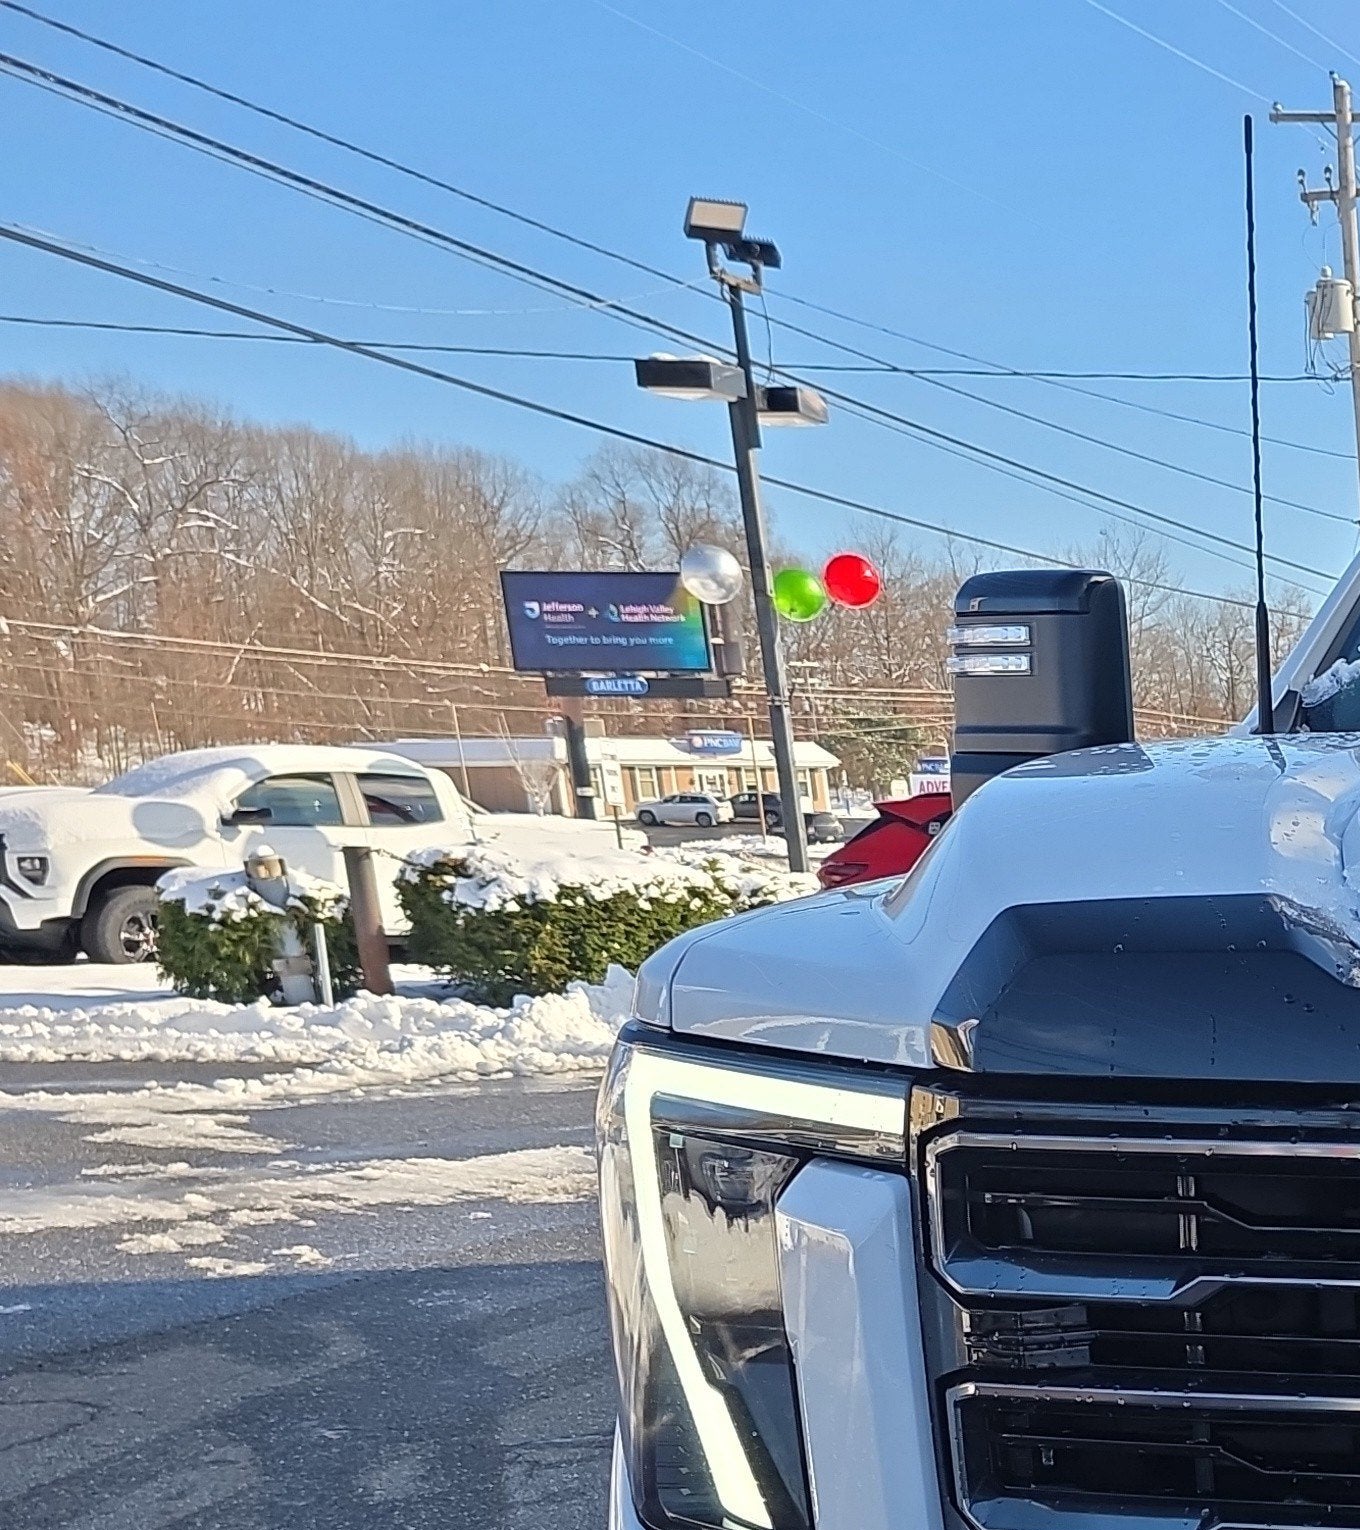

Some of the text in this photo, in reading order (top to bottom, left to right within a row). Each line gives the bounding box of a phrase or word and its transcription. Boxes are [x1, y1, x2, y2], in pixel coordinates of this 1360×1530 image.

[542, 601, 584, 612] Jefferson
[619, 604, 674, 614] Lehigh Valley
[543, 612, 575, 622] Health
[620, 613, 686, 622] Health Network
[545, 634, 674, 647] Together to bring you more
[592, 679, 643, 692] BARLETTA
